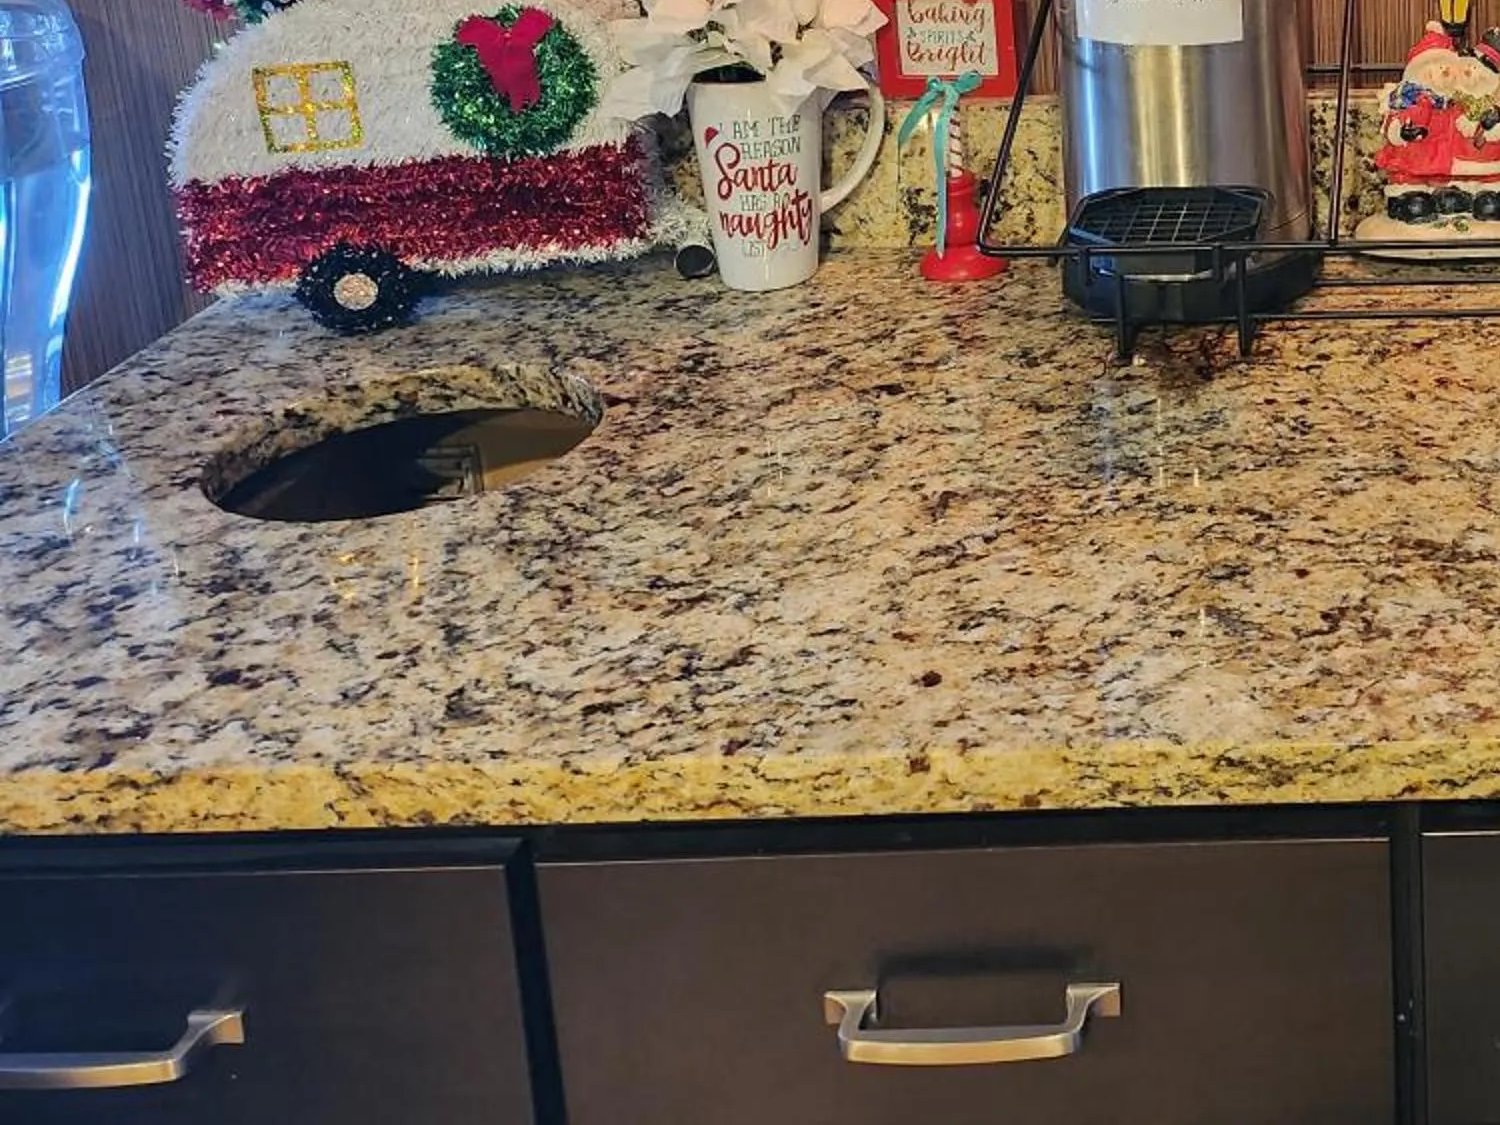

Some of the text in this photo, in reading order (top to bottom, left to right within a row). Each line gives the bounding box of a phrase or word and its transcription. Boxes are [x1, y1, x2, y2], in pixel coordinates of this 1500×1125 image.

[733, 121, 759, 139] AM
[741, 138, 801, 159] REASON
[715, 142, 798, 201] Santa
[719, 189, 813, 249] naughty
